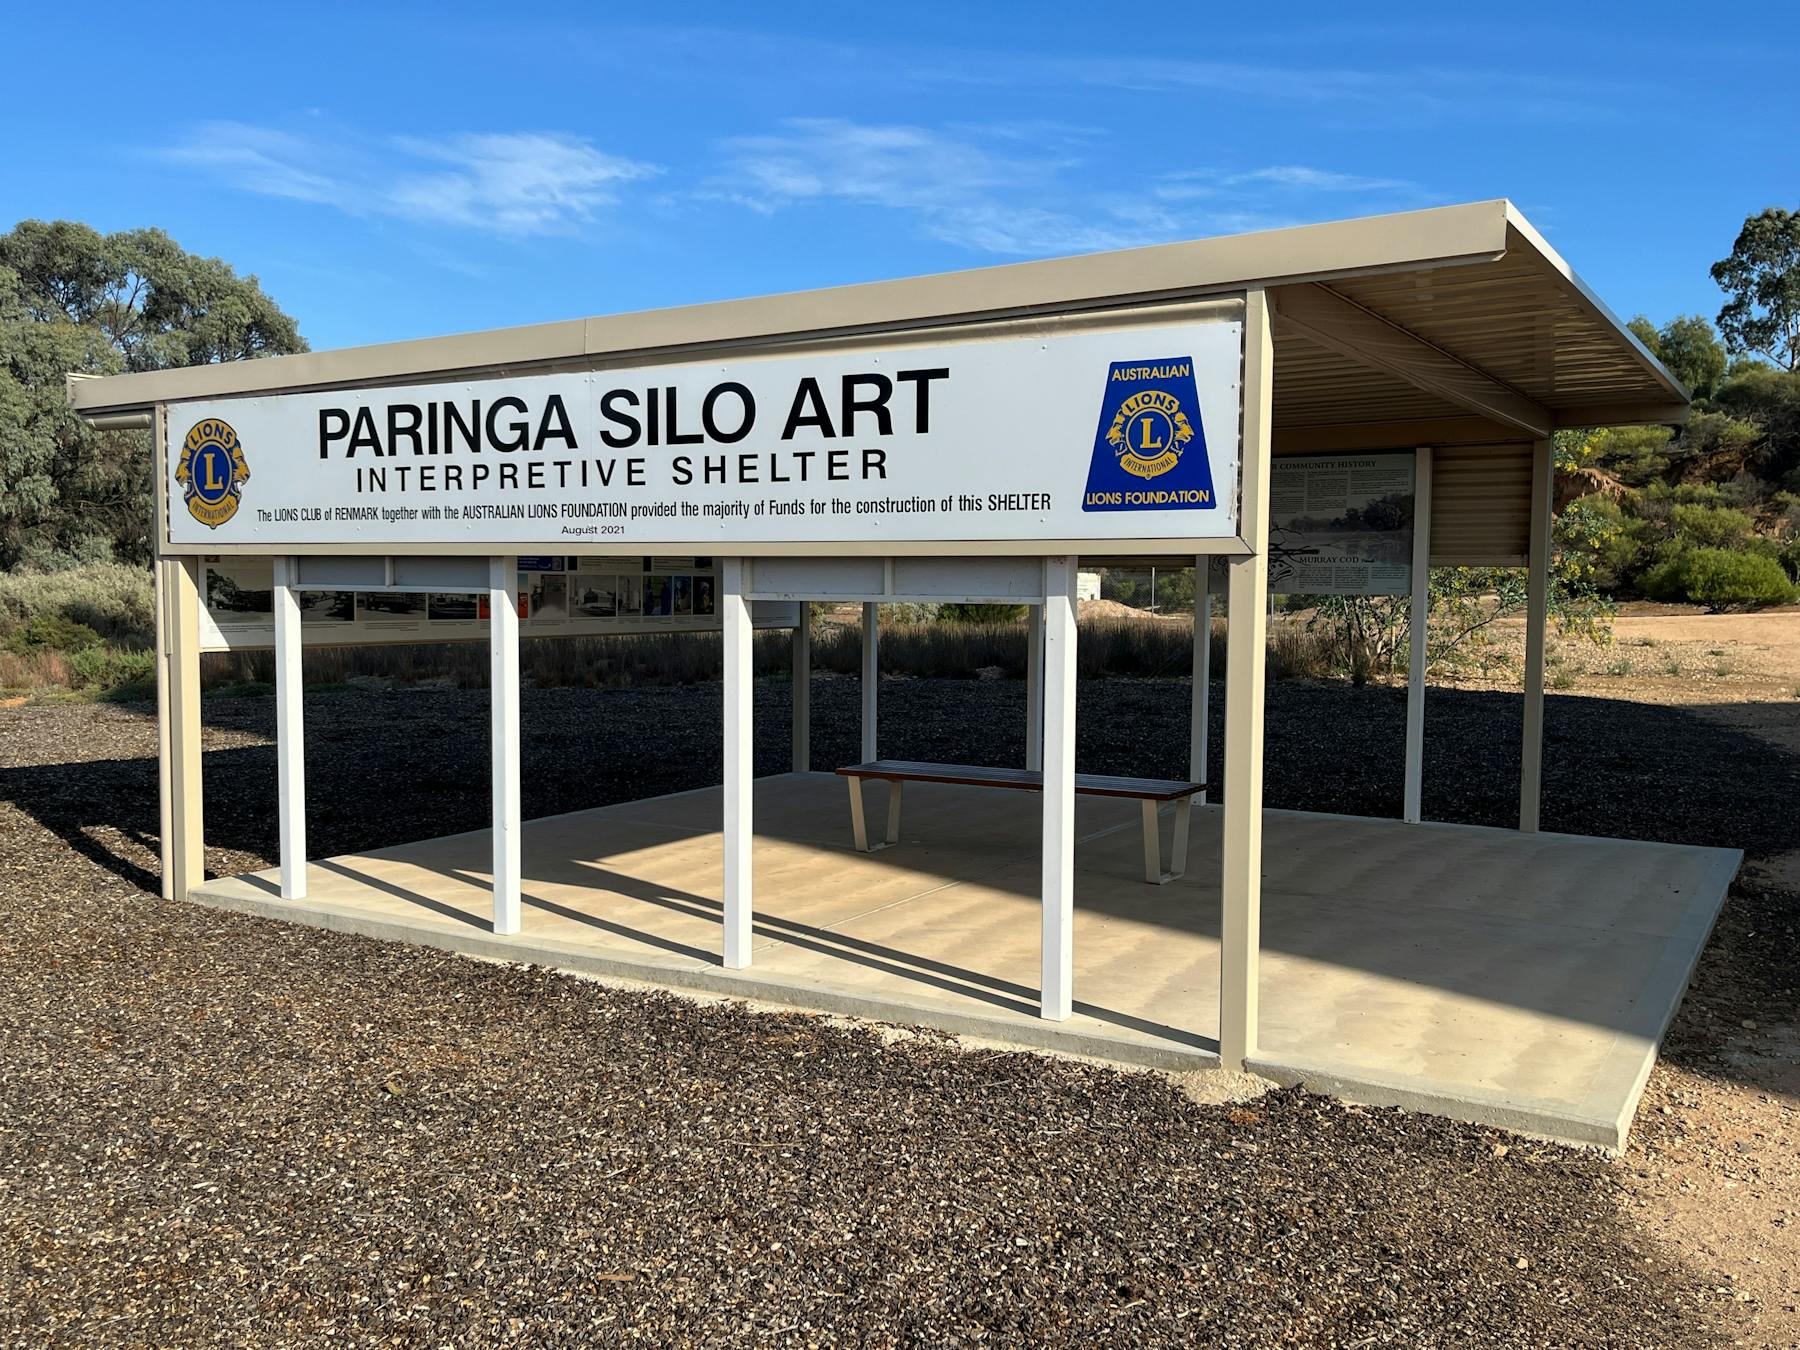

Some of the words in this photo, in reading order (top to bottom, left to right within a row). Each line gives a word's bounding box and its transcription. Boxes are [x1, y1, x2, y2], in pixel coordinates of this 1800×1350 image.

[1111, 363, 1190, 381] AUSTRALIAN
[1125, 393, 1176, 412] LIONS
[319, 395, 579, 460] PARINGA
[600, 382, 756, 449] SILO
[781, 367, 950, 441] ART
[190, 422, 233, 447] LIONS
[1139, 418, 1163, 449] L
[203, 453, 224, 490] L
[357, 457, 646, 493] INTERPRETIVE
[672, 448, 887, 486] SHELTER
[1123, 456, 1175, 474] INTERNATIONAL
[1279, 461, 1335, 471] COMMUNITY
[1338, 460, 1377, 469] HISTORY
[1086, 492, 1122, 505] LIONS
[1124, 489, 1210, 504] FOUNDATION
[192, 500, 236, 520] INTERNATIONAL
[257, 509, 272, 521] The
[274, 508, 299, 522] LIONS
[300, 507, 322, 521] CLUB
[324, 507, 333, 521] of
[335, 507, 379, 520] RENMARK
[382, 507, 418, 523] together
[421, 506, 441, 520] with
[444, 506, 459, 519] the
[463, 504, 525, 519] AUSTRALIAN
[527, 504, 558, 519] LIONS
[561, 502, 628, 518] FOUNDATION
[631, 501, 677, 520] provided
[681, 501, 699, 517] the
[703, 500, 750, 519] majority
[754, 500, 765, 515] of
[769, 499, 805, 515] Funds
[810, 499, 827, 515] for
[832, 498, 851, 514] the
[856, 496, 936, 514] construction
[940, 495, 953, 512] of
[958, 494, 983, 512] this
[988, 493, 1051, 511] SHELTER
[561, 525, 598, 536] August
[601, 525, 625, 534] 2021
[1300, 556, 1338, 564] MURRAY
[1339, 556, 1359, 564] COD
